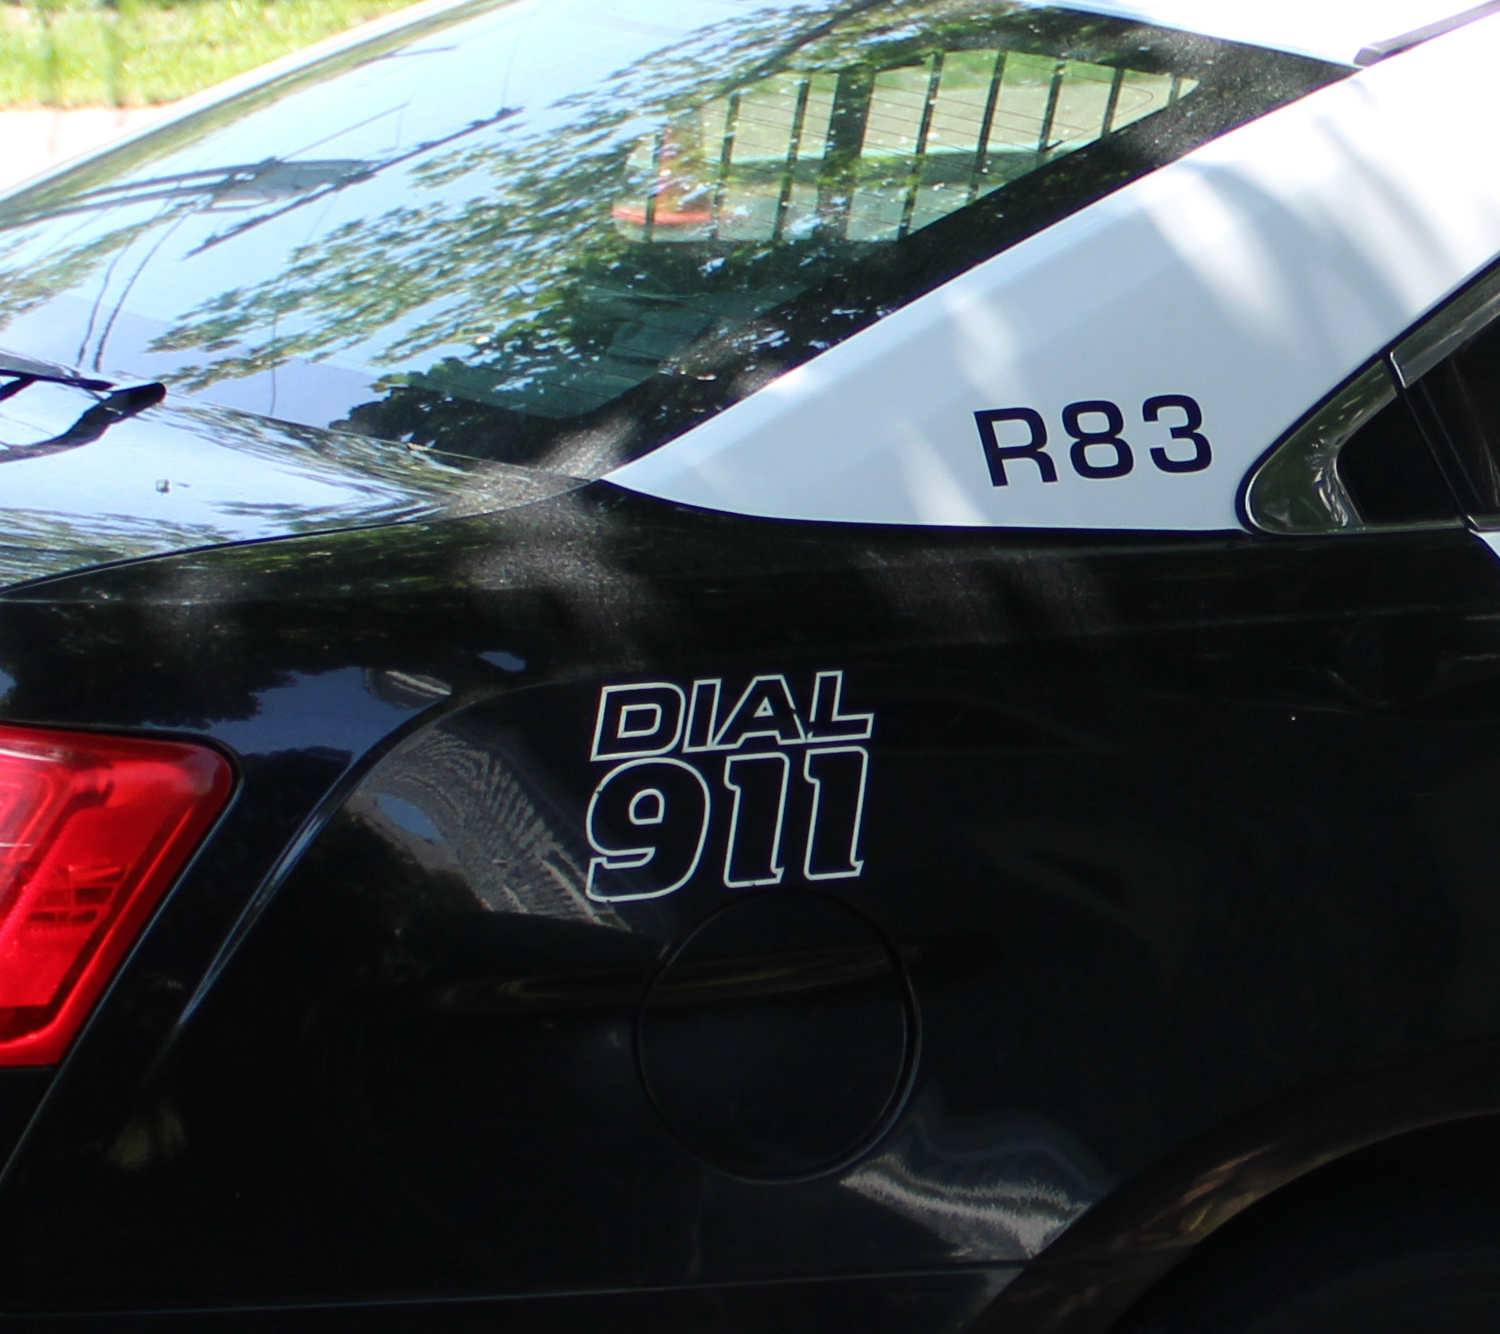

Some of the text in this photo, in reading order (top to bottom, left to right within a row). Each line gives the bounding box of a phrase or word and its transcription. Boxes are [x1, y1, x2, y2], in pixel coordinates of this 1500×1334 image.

[973, 394, 1212, 487] R83
[590, 670, 874, 761] DIAL
[586, 746, 868, 902] 911
